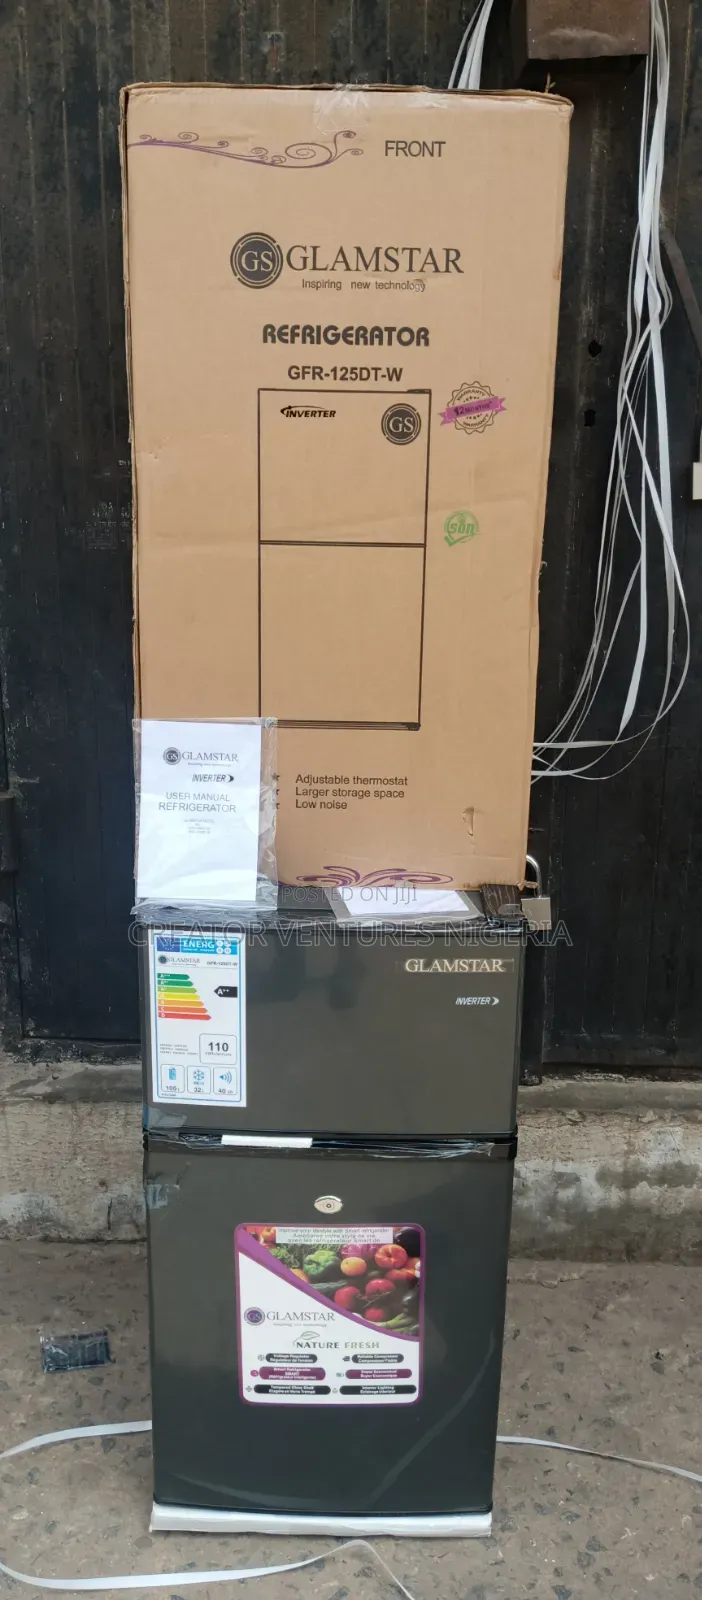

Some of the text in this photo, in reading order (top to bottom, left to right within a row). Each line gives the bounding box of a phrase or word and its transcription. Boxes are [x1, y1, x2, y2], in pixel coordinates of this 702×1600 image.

[384, 139, 446, 158] FRONT
[240, 245, 464, 274] GS GLAMSTAR
[302, 278, 426, 292] Inspiring new technology
[262, 324, 430, 347] REFRIGERATOR
[287, 366, 403, 382] GFR-125DT-W
[285, 409, 337, 419] INVERTER
[388, 416, 414, 433] GS
[181, 752, 239, 762] GLAMSTAR
[191, 774, 226, 783] INVERTER
[295, 773, 409, 786] Adjustable thermostat
[165, 792, 230, 802] USER MANUAL
[295, 786, 405, 801] Larger storage space
[158, 802, 237, 813] REFRIGERATOR
[295, 799, 348, 810] Low noise
[168, 956, 201, 964] GLAMSTAR
[404, 958, 505, 973] GLAMSTAR
[455, 996, 491, 1006] INVERTER
[208, 1042, 229, 1052] 110
[266, 1311, 336, 1322] GLAMSTAR
[296, 1341, 380, 1349] NATURE FRESH
